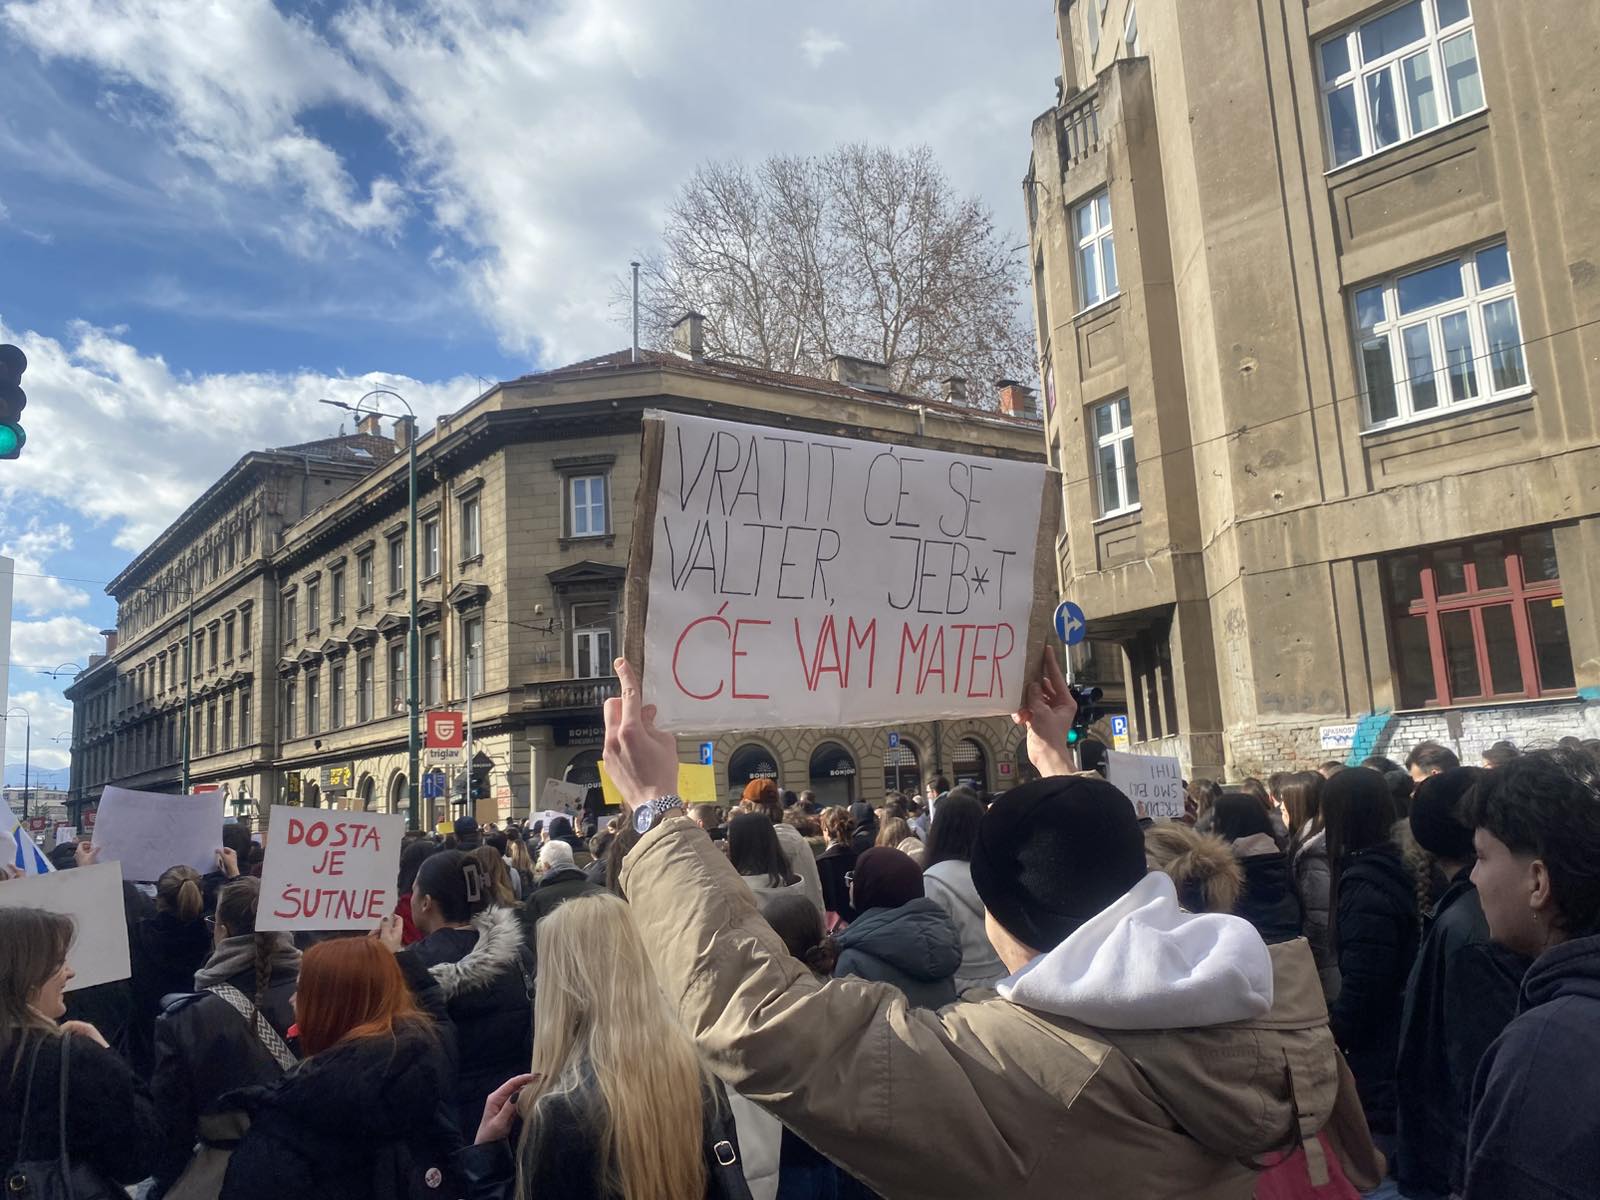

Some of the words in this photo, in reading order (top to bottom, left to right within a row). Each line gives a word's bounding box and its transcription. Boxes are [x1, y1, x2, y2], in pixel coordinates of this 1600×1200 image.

[677, 426, 851, 521] VRATIT
[864, 446, 924, 528] ĆE
[939, 461, 992, 541] SE
[664, 516, 841, 606] VALTER,
[672, 601, 771, 700] ĆE
[795, 615, 876, 692] VAM
[896, 622, 1014, 698] MATER
[430, 749, 459, 760] triglav
[287, 818, 380, 851] DOSTA
[312, 851, 346, 875] JE
[274, 883, 385, 919] ŠUTNJE
